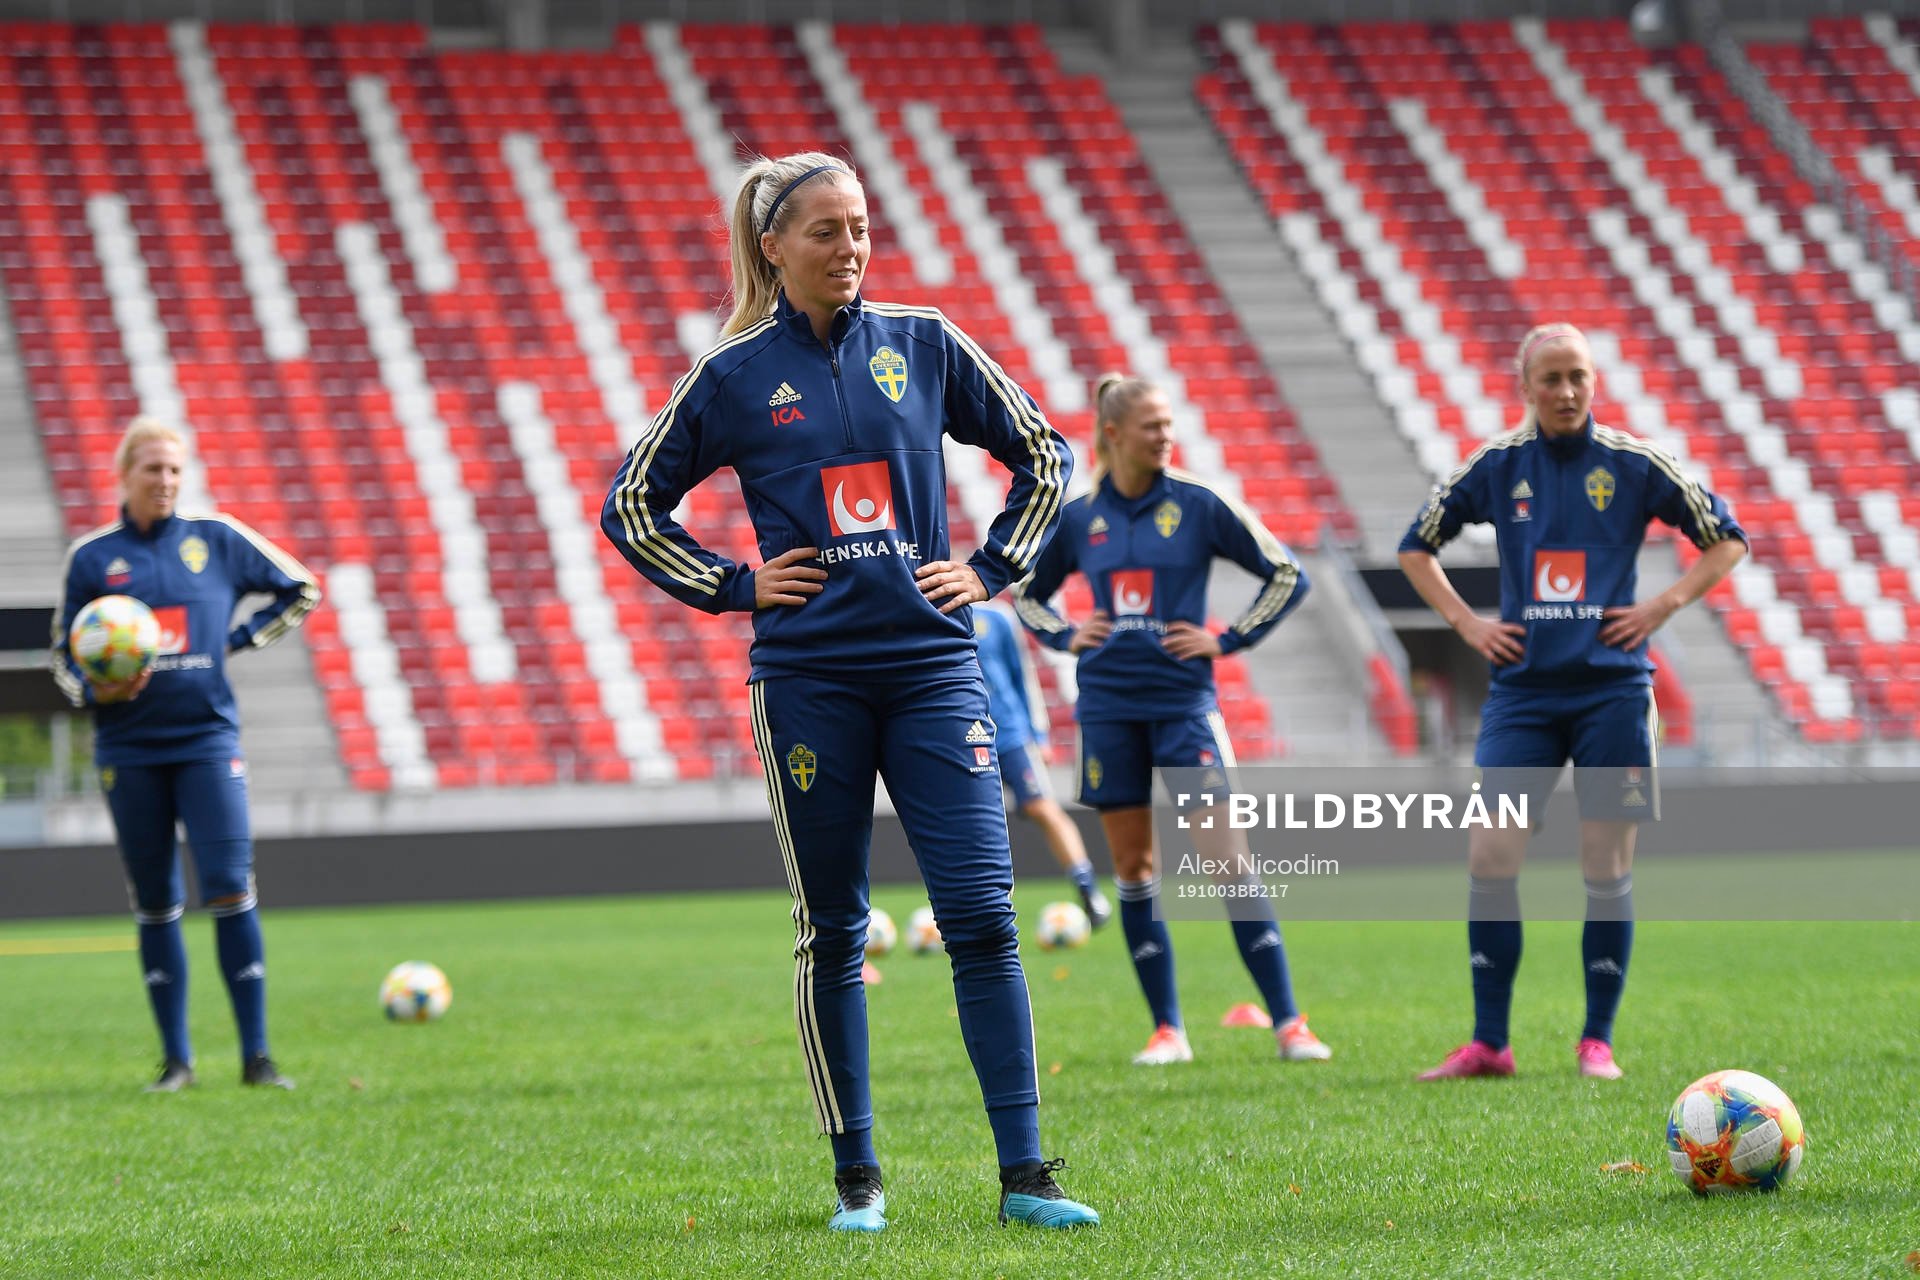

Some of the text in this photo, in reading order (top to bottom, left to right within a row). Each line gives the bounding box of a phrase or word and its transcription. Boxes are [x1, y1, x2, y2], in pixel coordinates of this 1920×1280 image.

[769, 393, 802, 406] adidas
[771, 406, 806, 427] ICA
[816, 539, 922, 565] VENSKA SPE
[1523, 604, 1605, 621] VENSKA SPE
